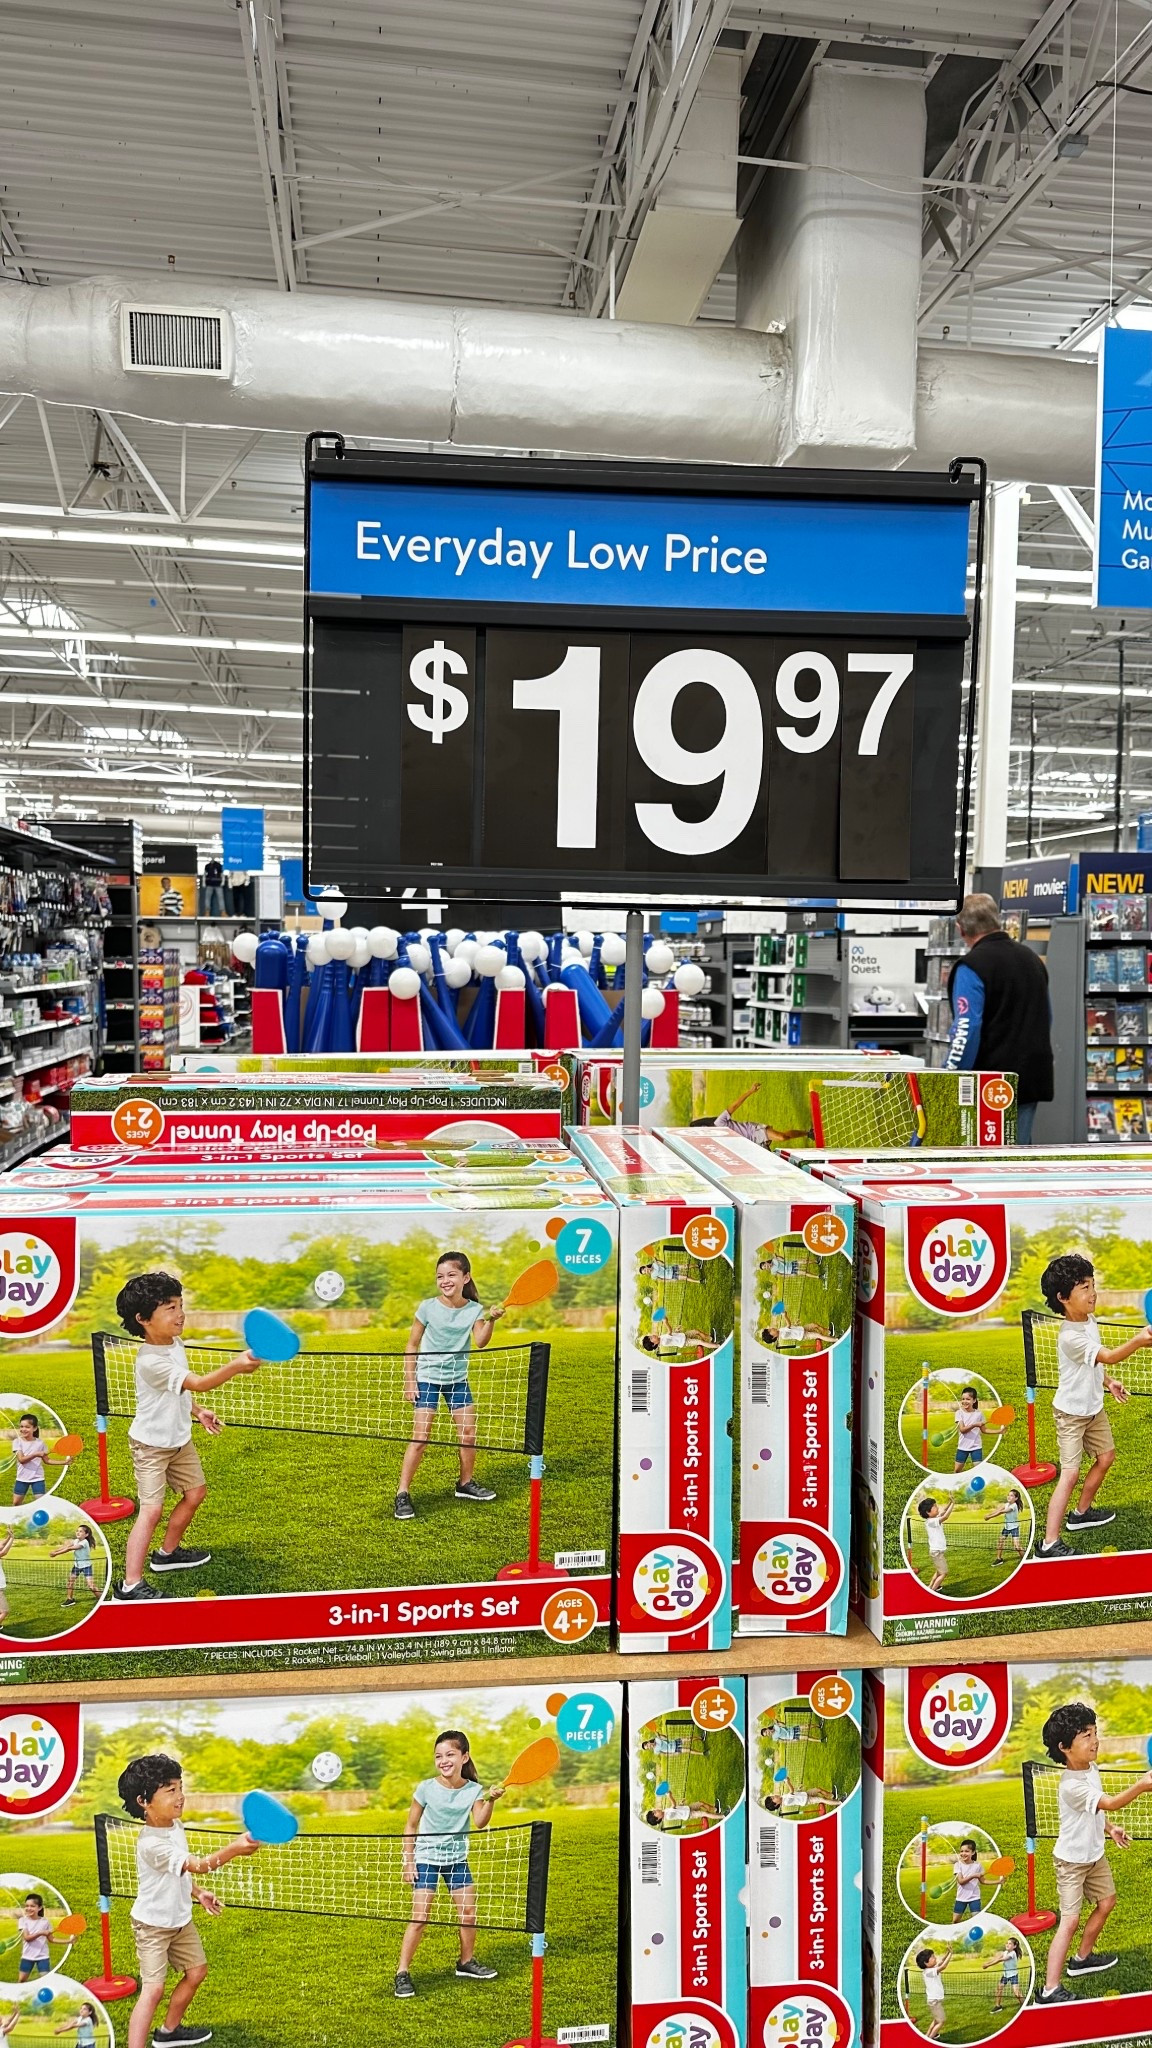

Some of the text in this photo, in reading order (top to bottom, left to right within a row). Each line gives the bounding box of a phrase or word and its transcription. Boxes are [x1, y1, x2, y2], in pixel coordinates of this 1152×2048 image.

[356, 520, 768, 579] Everyday Low Price
[1121, 549, 1152, 570] Ga
[406, 640, 914, 856] $ 19 97
[142, 856, 165, 865] parel
[1003, 879, 1028, 899] NEW!
[1086, 873, 1145, 894] NEW!
[851, 955, 877, 965] Meta
[851, 964, 881, 974] Quest
[158, 1097, 178, 1108] cm)
[181, 1097, 199, 1107] 183
[211, 1098, 227, 1107] cm
[266, 1097, 277, 1107] IN
[280, 1097, 292, 1107] 72
[304, 1097, 323, 1107] DIA
[324, 1097, 335, 1107] IN
[337, 1096, 349, 1107] 17
[352, 1096, 385, 1107] Tunnel
[387, 1095, 408, 1107] Play
[411, 1095, 448, 1107] Pop-Up
[994, 1084, 1009, 1104] 3+
[121, 1107, 154, 1128] 2+
[126, 1129, 151, 1138] AGES
[170, 1119, 377, 1147] Pop-Up Play Tunnel
[984, 1120, 997, 1142] Set
[260, 1152, 326, 1162] Sports
[247, 1173, 320, 1182] Sports
[161, 1198, 225, 1206] 3-in-1
[231, 1196, 311, 1206] Sports
[576, 1228, 593, 1253] 7
[691, 1226, 699, 1248] AGES
[700, 1222, 720, 1251] 4+
[810, 1224, 819, 1245] AGES
[819, 1219, 840, 1248] 4+
[565, 1254, 602, 1264] PIECES
[929, 1234, 988, 1264] play
[0, 1249, 52, 1279] lay
[933, 1259, 983, 1286] day
[683, 1376, 703, 1518] 3-in-1 Sports Set
[802, 1369, 822, 1509] 3-in-1 Sports Set
[767, 1540, 794, 1596] play
[789, 1546, 818, 1593] day
[648, 1553, 676, 1612] play
[671, 1558, 699, 1608] day
[328, 1595, 520, 1626] 3-in-1 Sports Set
[557, 1598, 583, 1608] AGES
[552, 1610, 588, 1634] 4+
[914, 1617, 959, 1629] WARNING:
[284, 1657, 290, 1665] 2
[291, 1655, 326, 1664] Rackets,
[381, 1650, 422, 1660] Volleyball,
[430, 1648, 455, 1658] Swing
[456, 1647, 472, 1655] Ball
[487, 1645, 515, 1653] Inflator
[293, 1647, 320, 1656] Racket
[322, 1646, 337, 1654] Net
[346, 1644, 364, 1652] 74.8
[366, 1643, 376, 1651] IN
[376, 1643, 386, 1651] W
[394, 1642, 412, 1650] 33.4
[414, 1641, 424, 1649] IN
[480, 1637, 498, 1645] 84.8
[817, 1687, 826, 1709] AGES
[825, 1682, 845, 1711] 4+
[930, 1690, 989, 1719] play
[576, 1704, 594, 1729] 7
[700, 1699, 708, 1720] AGES
[708, 1694, 728, 1722] 4+
[566, 1730, 604, 1741] PIECES
[933, 1714, 983, 1741] day
[809, 1835, 828, 1970] 3-in-1 Sports Set
[692, 1850, 712, 1987] 3-in-1 Sports Set
